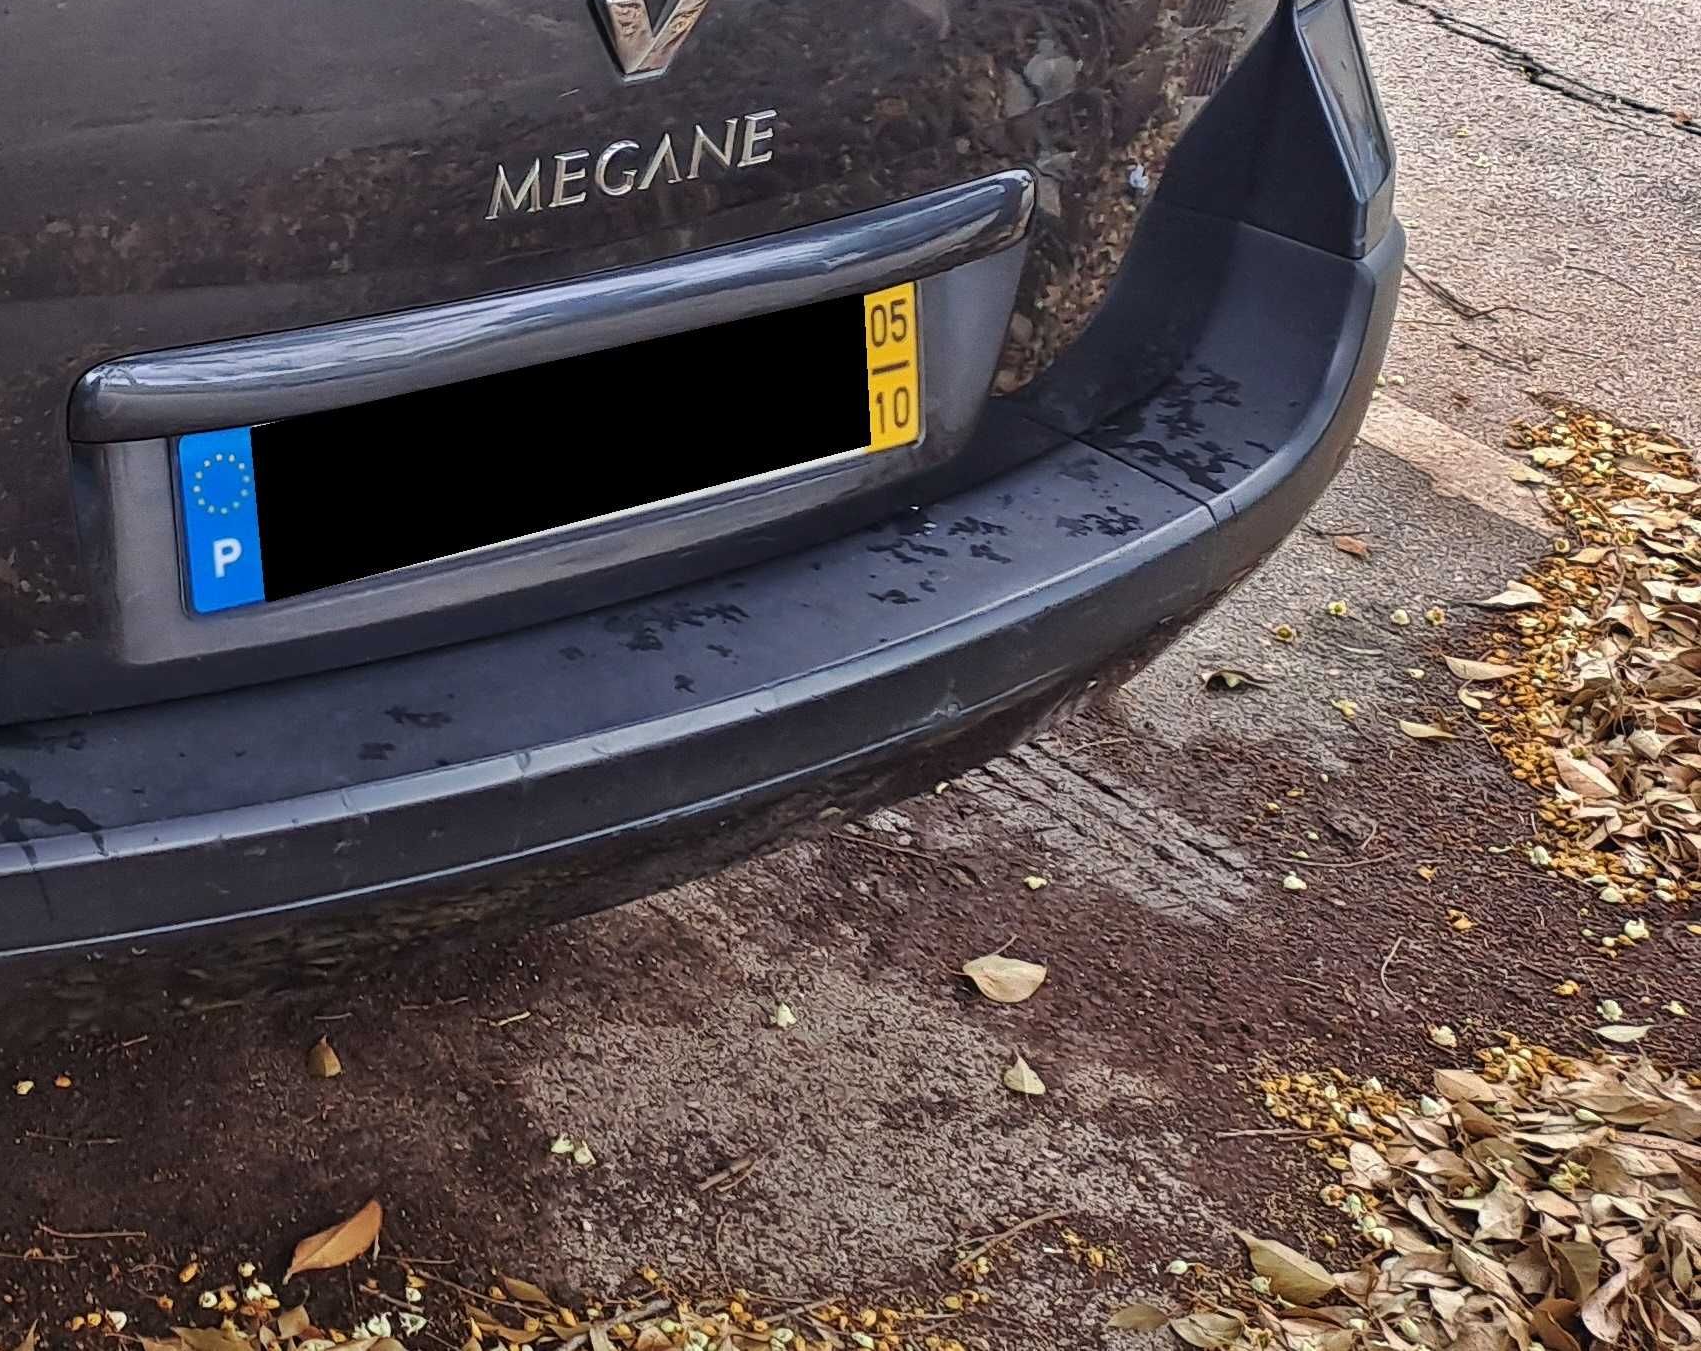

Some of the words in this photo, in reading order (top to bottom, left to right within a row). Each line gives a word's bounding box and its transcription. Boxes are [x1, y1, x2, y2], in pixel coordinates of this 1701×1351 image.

[484, 109, 777, 220] MEGANE
[870, 299, 908, 347] 05
[876, 386, 910, 434] 10
[213, 538, 242, 578] P
